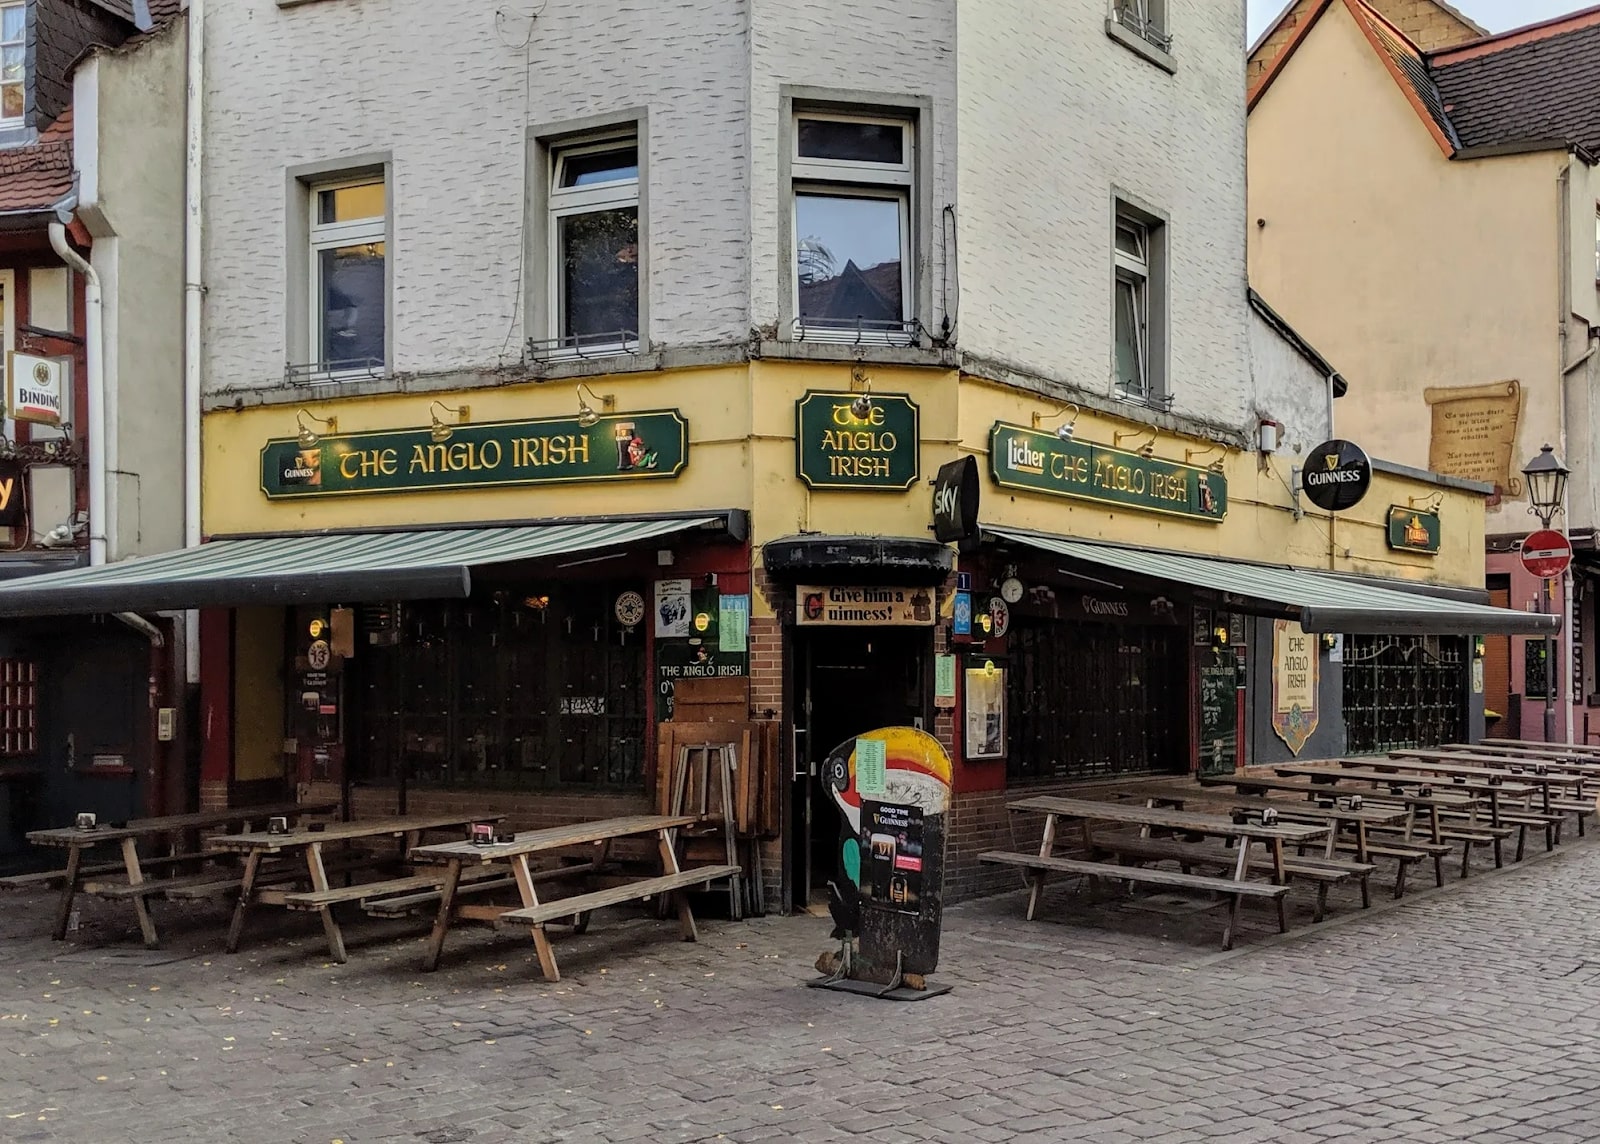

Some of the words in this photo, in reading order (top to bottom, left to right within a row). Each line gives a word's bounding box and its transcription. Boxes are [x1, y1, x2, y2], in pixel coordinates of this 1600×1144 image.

[19, 388, 59, 410] BINDING
[820, 430, 897, 452] ANGLO
[338, 448, 398, 479] THE
[408, 438, 502, 473] ANGLO
[511, 433, 590, 468] IRISH
[1007, 436, 1045, 470] Licher
[284, 468, 314, 480] GUINNESS
[828, 455, 890, 477] IRISH
[1050, 452, 1088, 483] THE
[1093, 459, 1146, 495] ANGLO
[1149, 471, 1188, 503] IRISH
[1308, 470, 1360, 486] GUINNESS
[934, 481, 958, 521] sky
[960, 574, 966, 588] 1
[829, 586, 862, 603] Give
[864, 586, 893, 603] him
[895, 592, 905, 603] a
[1089, 597, 1129, 617] GUINNESS
[1289, 636, 1304, 652] THE
[660, 665, 680, 676] THE
[682, 665, 715, 676] ANGLO
[717, 665, 742, 676] IRISH
[1284, 656, 1309, 672] ANGLO
[1288, 674, 1307, 689] IRISH
[880, 806, 896, 814] GOOD
[896, 808, 909, 816] TIME
[879, 816, 908, 827] GUINNESS
